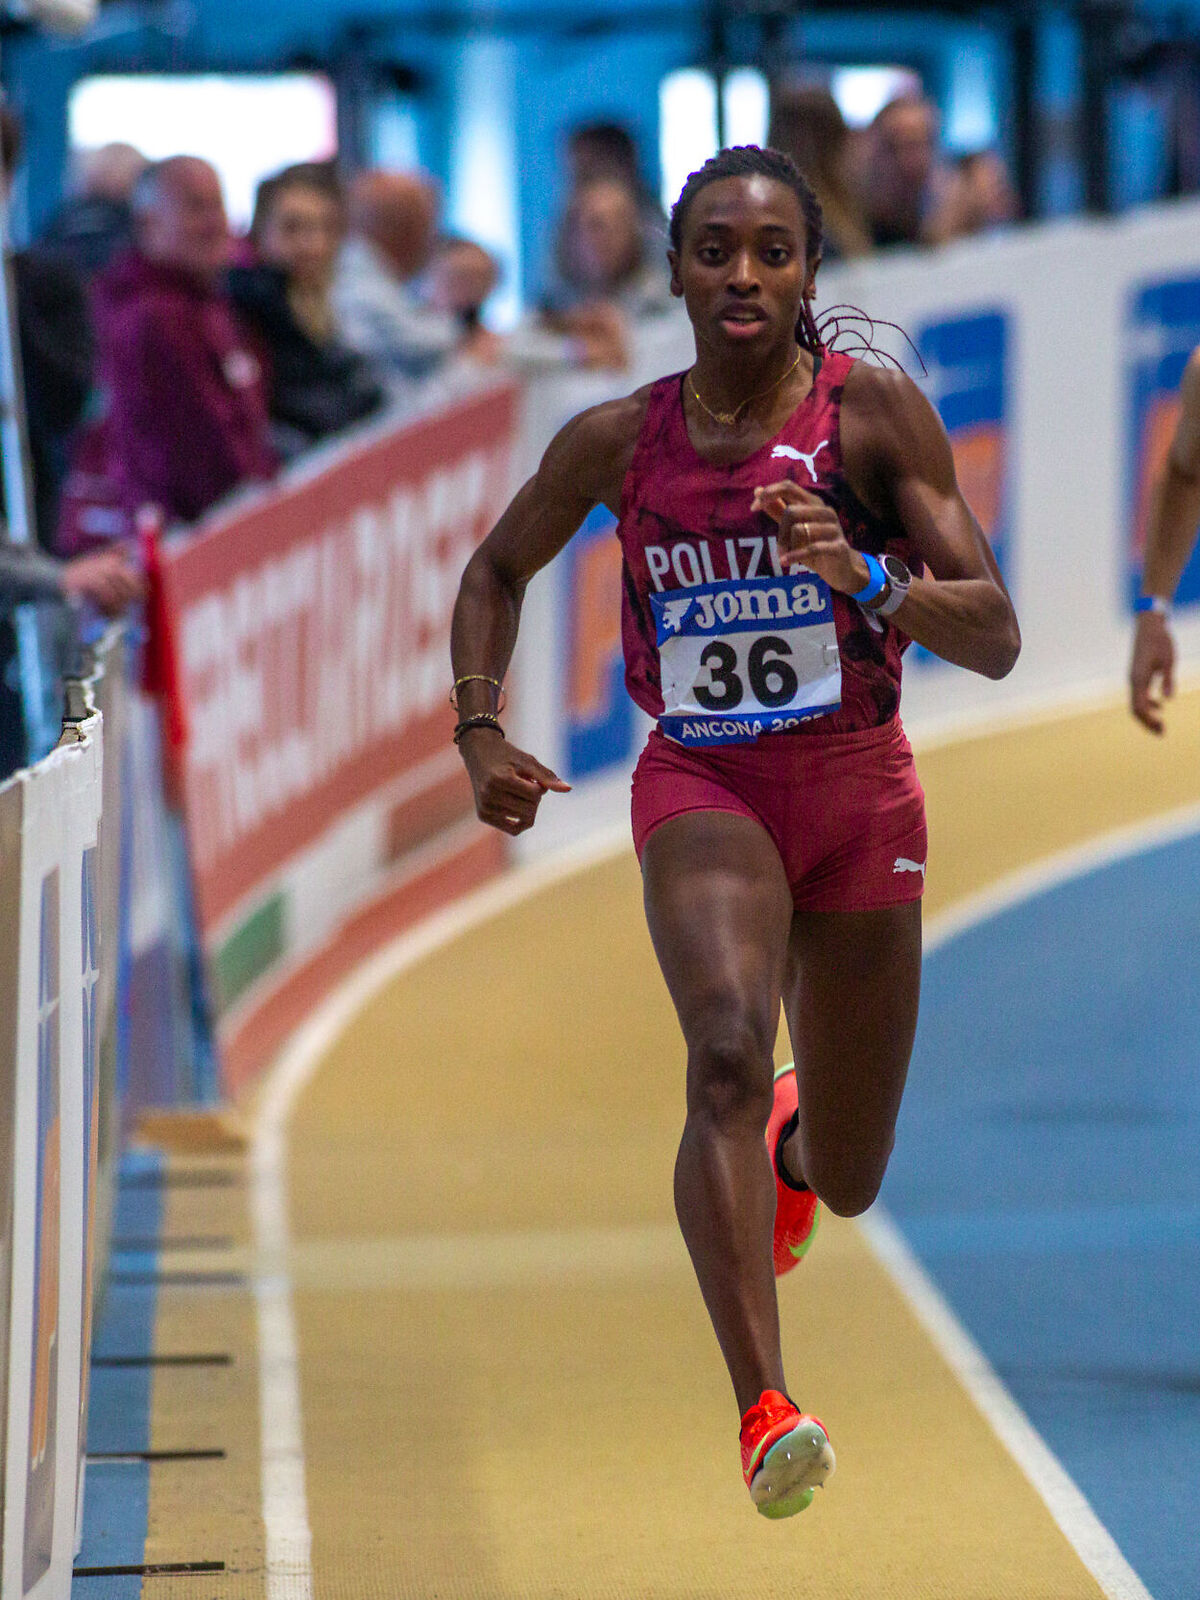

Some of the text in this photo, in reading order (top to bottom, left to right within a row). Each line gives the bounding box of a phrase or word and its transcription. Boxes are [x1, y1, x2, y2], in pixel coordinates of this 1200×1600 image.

[645, 536, 818, 592] POLIZI
[692, 636, 799, 711] 36
[682, 719, 763, 739] ANCONA
